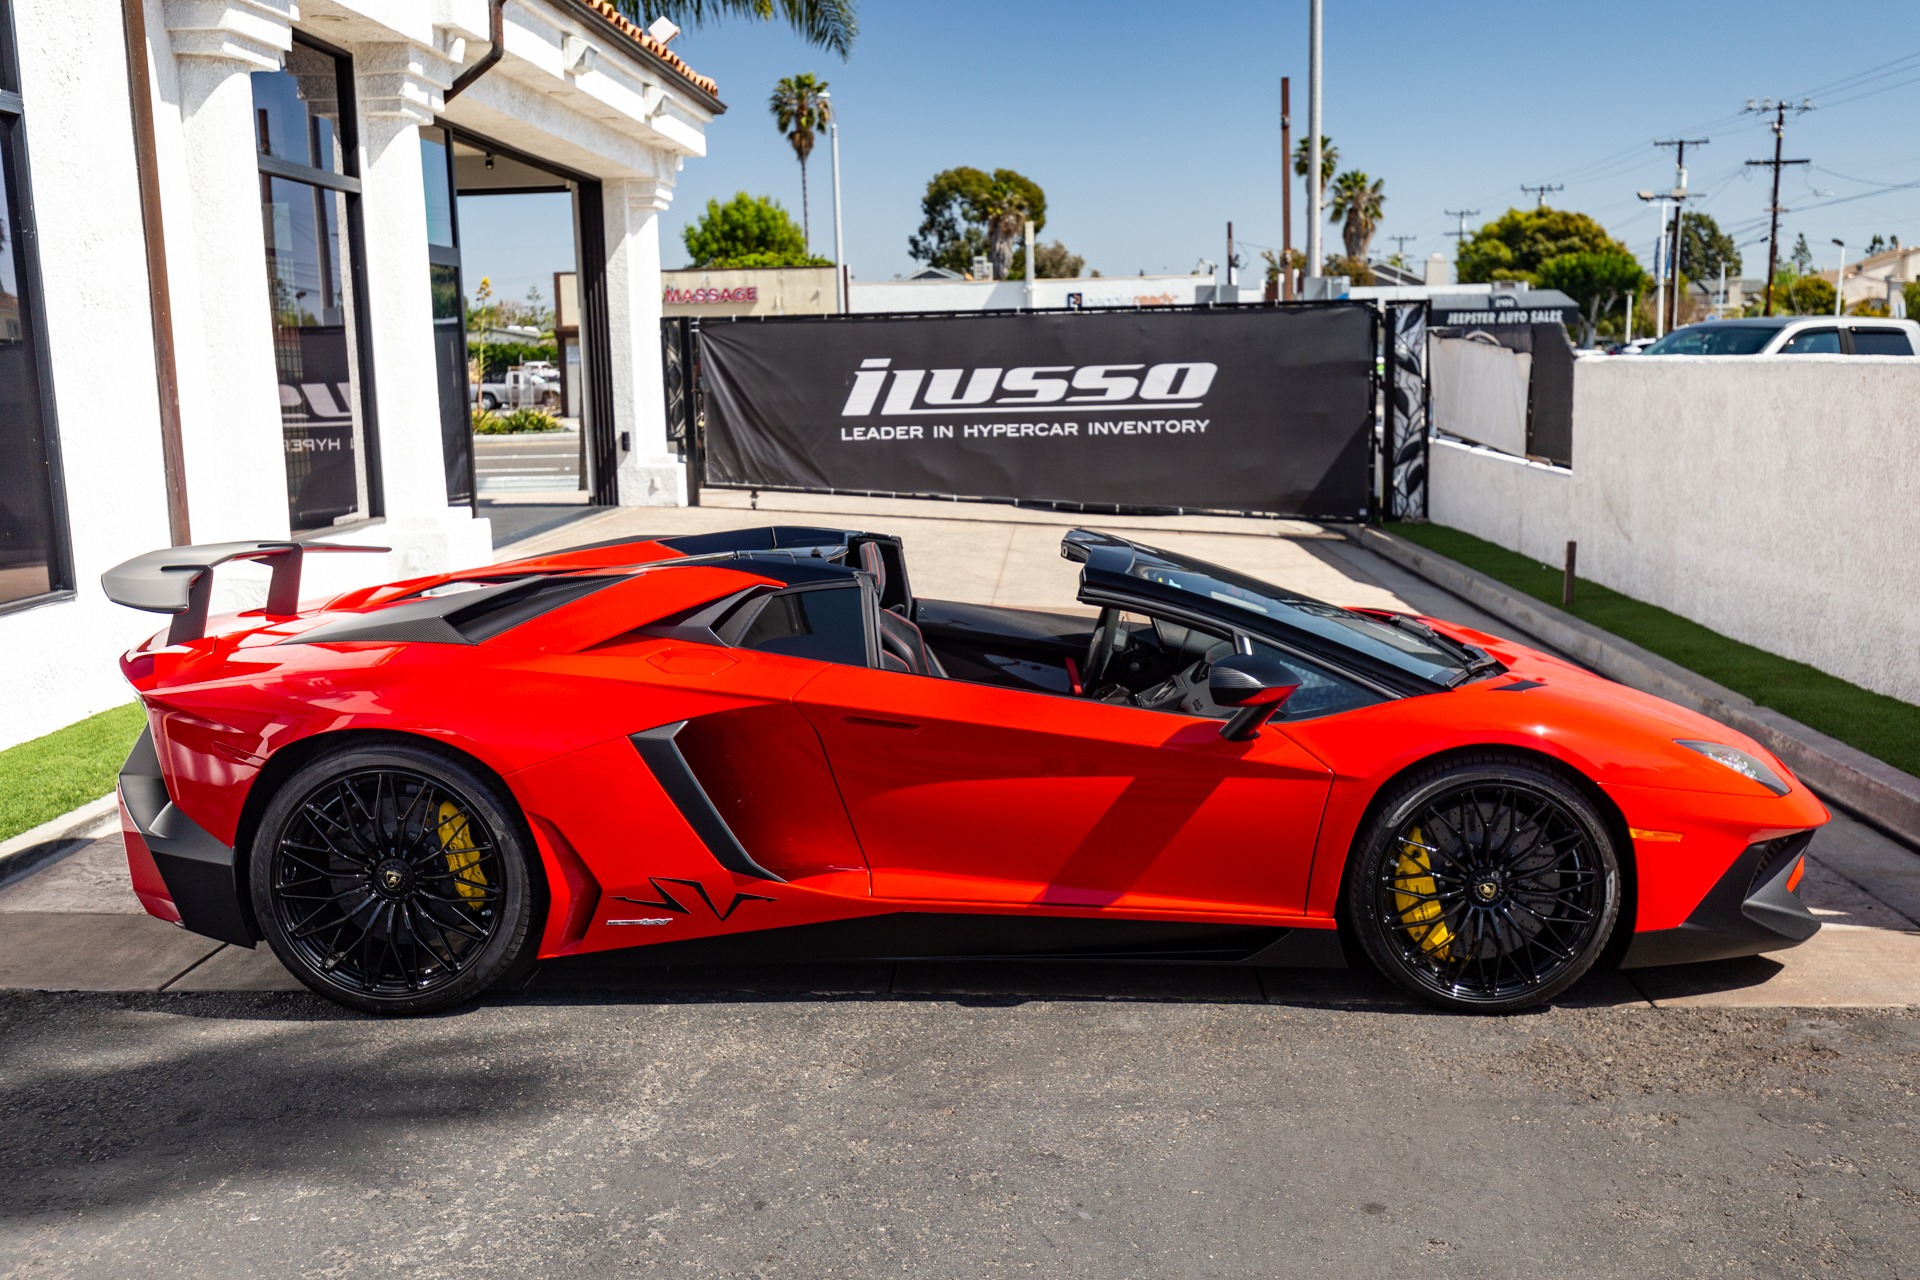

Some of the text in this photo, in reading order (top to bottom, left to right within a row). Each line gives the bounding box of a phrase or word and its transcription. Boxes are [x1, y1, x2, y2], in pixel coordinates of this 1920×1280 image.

[665, 287, 758, 302] MASSAGE
[1447, 310, 1563, 325] JEEPSTER AUTO SALES
[841, 419, 1210, 441] LEADER IN HYPERCAR INVENTORY
